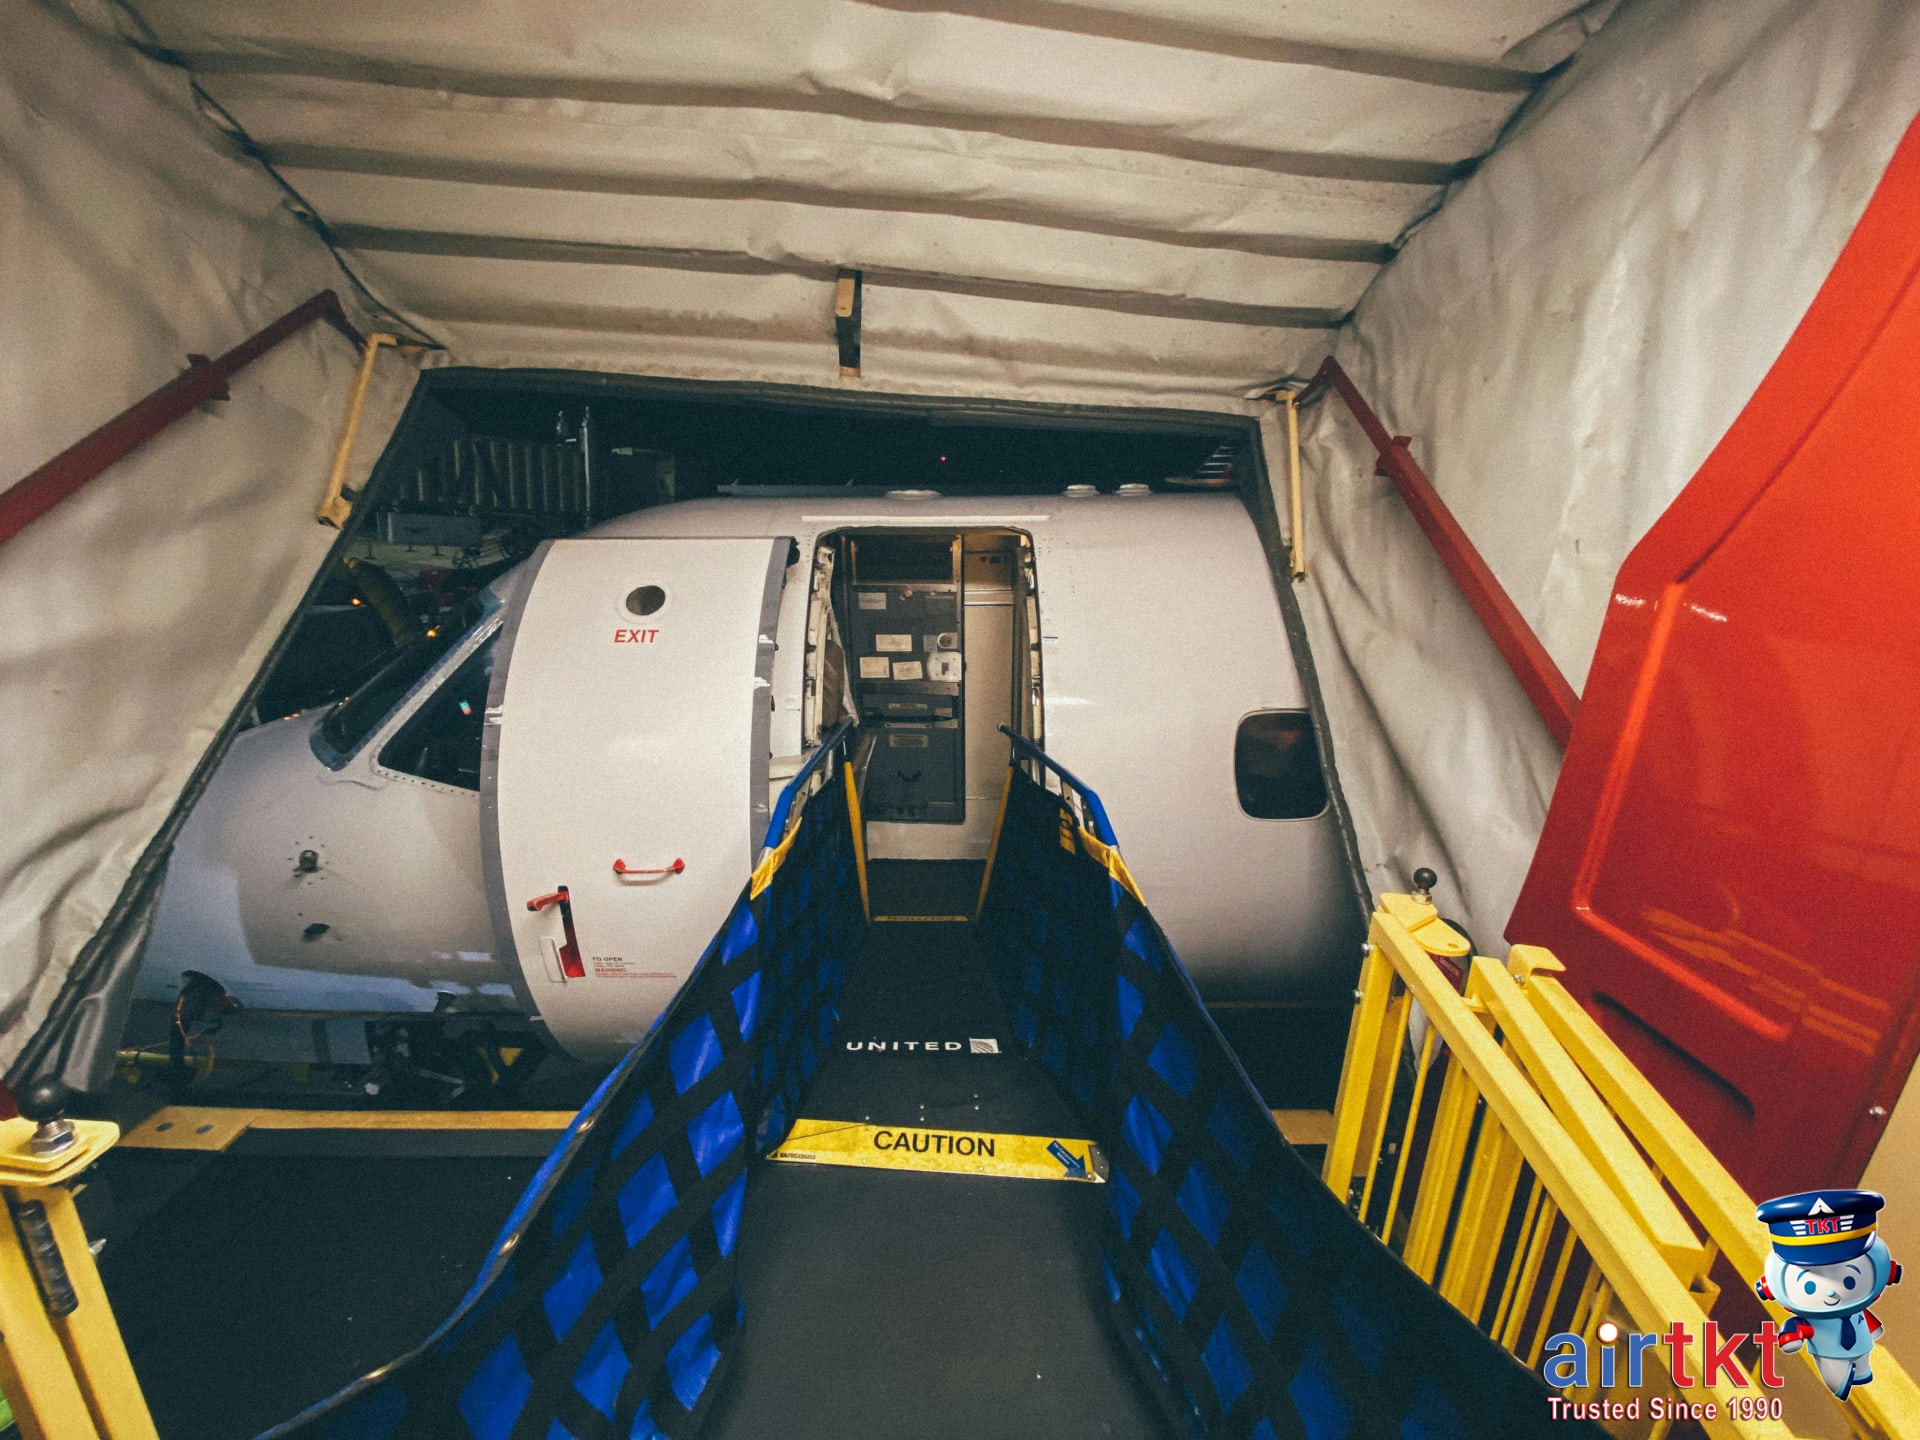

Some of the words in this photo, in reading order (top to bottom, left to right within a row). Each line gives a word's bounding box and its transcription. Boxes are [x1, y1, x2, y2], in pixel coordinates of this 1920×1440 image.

[613, 629, 659, 643] EXIT
[846, 1041, 962, 1051] UNITED
[873, 1130, 996, 1157] CAUTION
